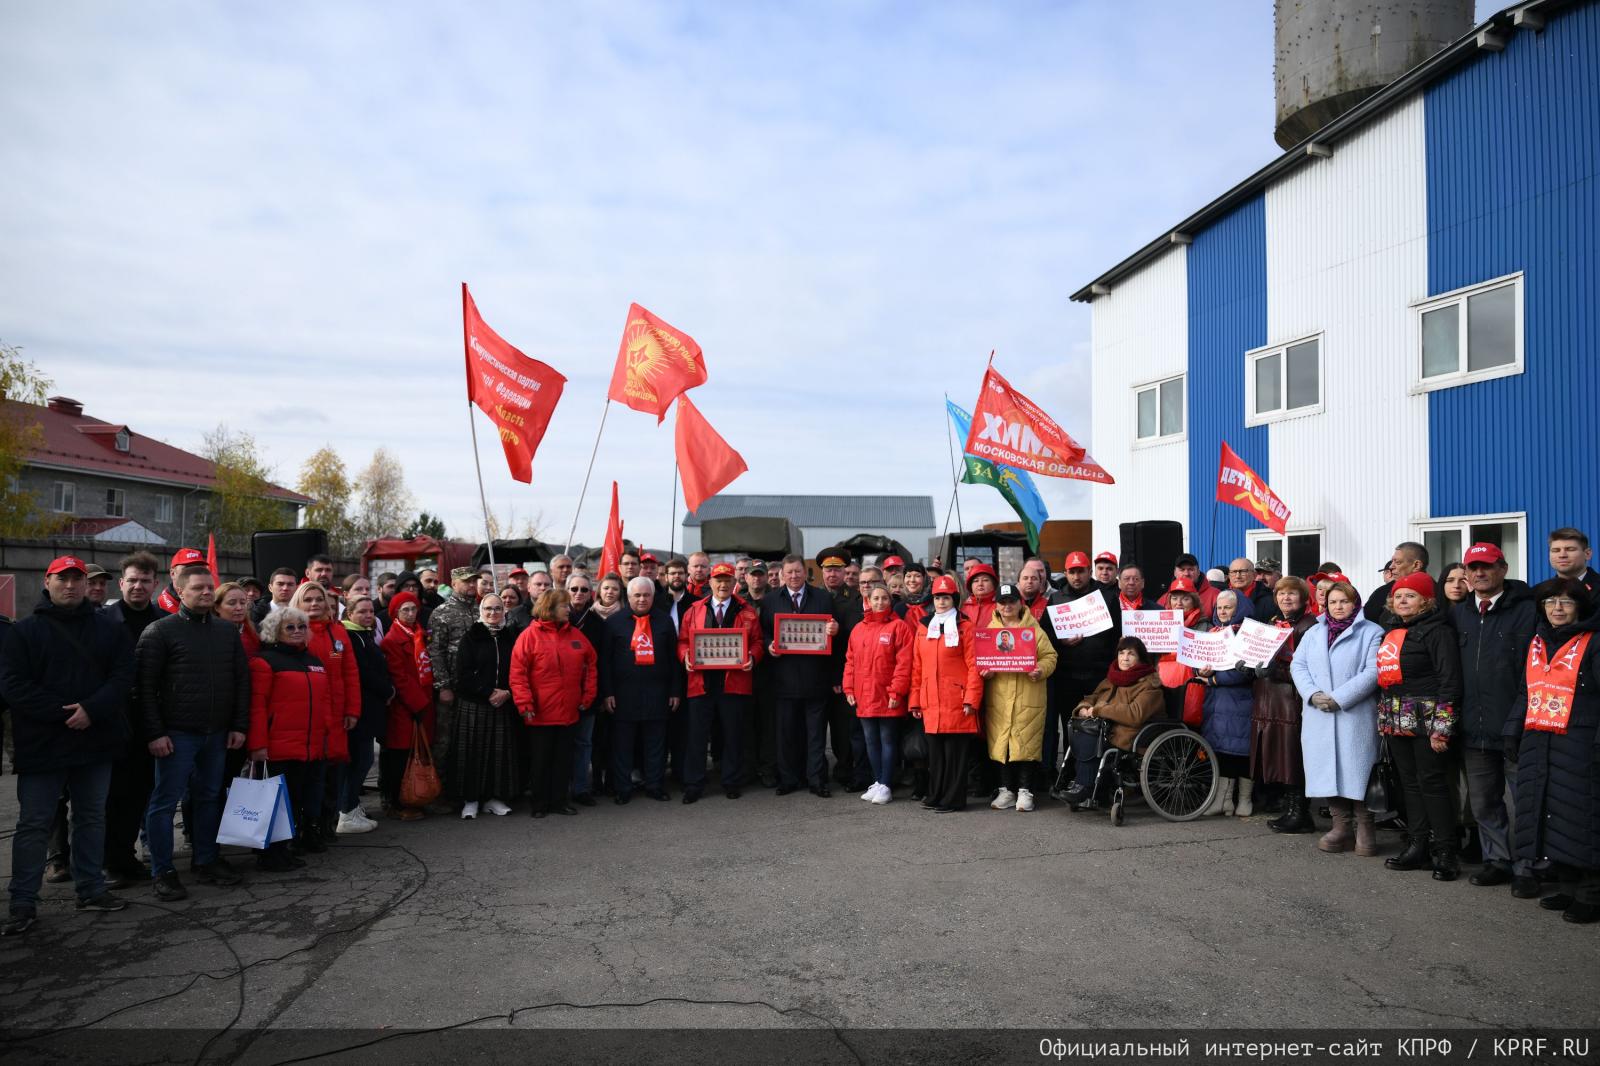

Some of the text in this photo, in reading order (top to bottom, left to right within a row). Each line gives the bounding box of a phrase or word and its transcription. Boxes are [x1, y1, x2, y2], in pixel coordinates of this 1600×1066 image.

[495, 381, 532, 409] Федерации
[974, 441, 1106, 480] МОСКОВСКАЯ ОБЛАСТЬ
[972, 462, 993, 480] ЗА
[1220, 466, 1252, 492] ДЕТИ
[1054, 614, 1077, 623] РУКИ
[1068, 611, 1109, 630] РОССИИ!
[1380, 664, 1399, 673] КПРФ
